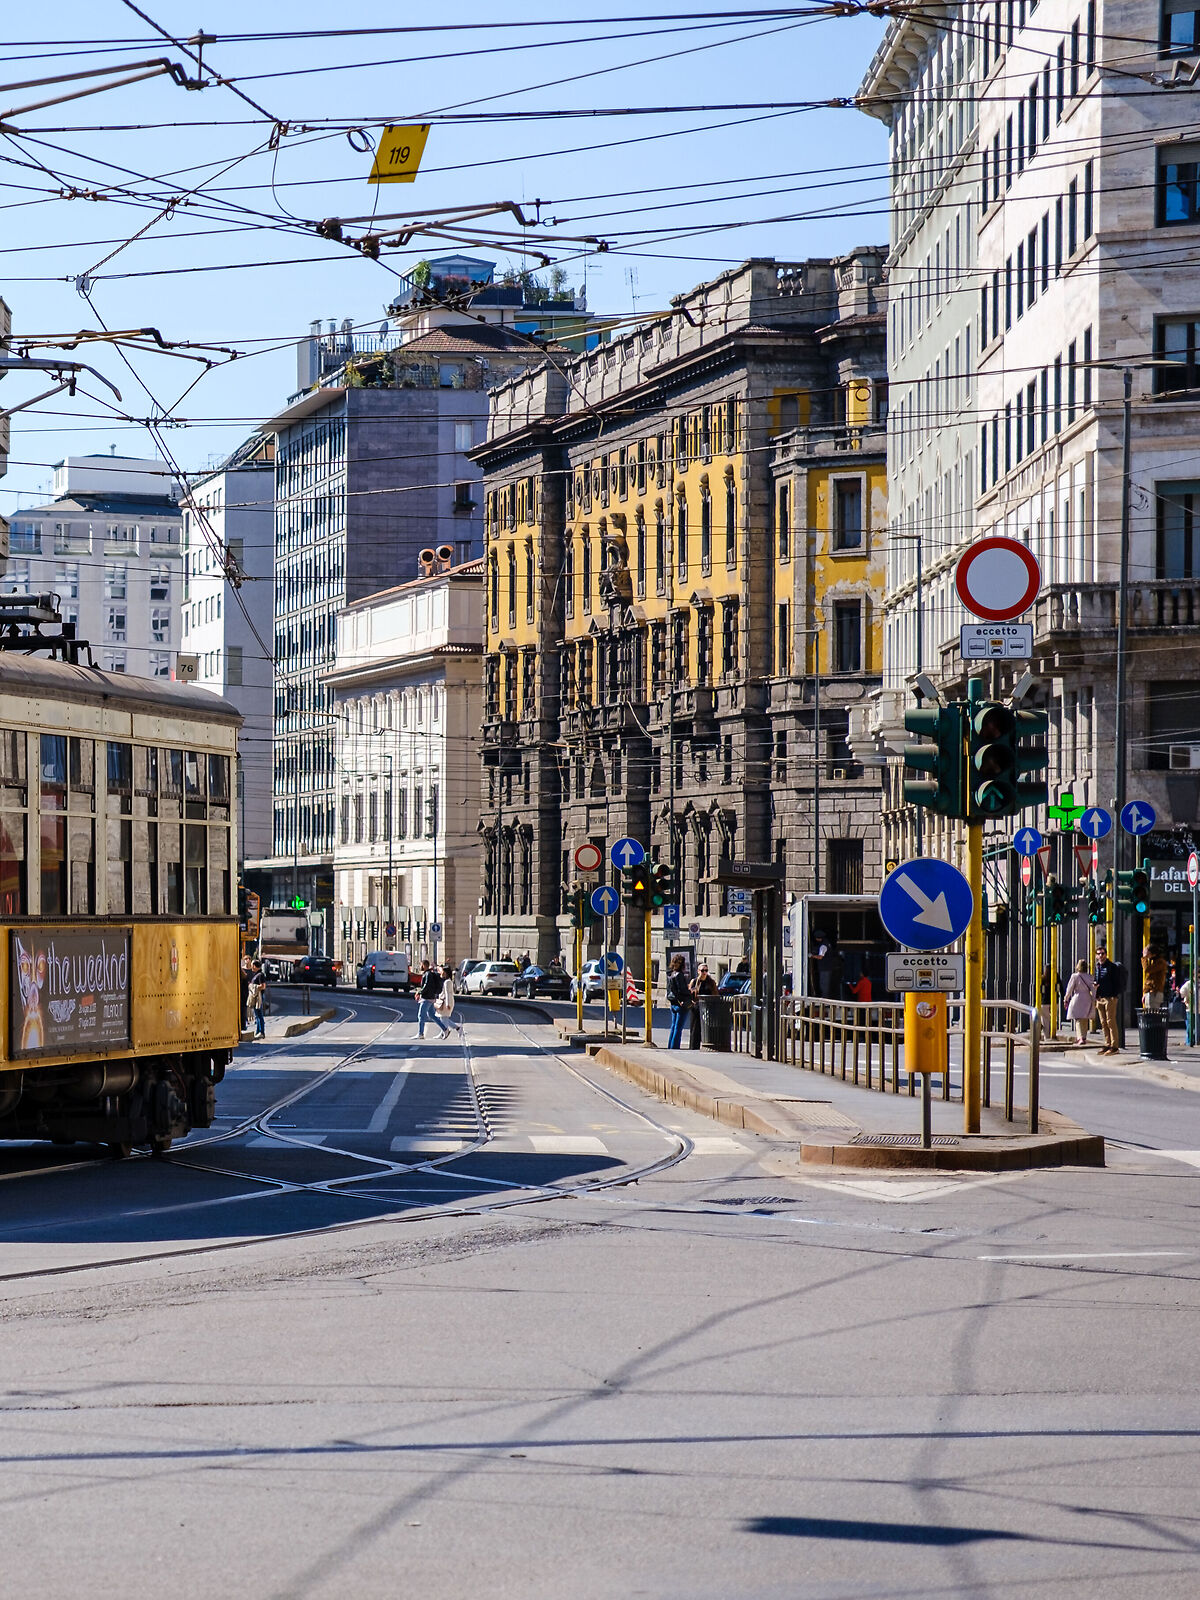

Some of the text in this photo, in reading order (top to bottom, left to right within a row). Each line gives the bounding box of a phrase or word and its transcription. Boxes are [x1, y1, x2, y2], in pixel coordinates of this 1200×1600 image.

[389, 146, 410, 165] 119
[975, 627, 1018, 636] eccetto
[180, 664, 194, 673] 76
[1164, 882, 1187, 893] DEL
[667, 908, 676, 918] P
[47, 938, 128, 995] the weeknd
[902, 957, 948, 966] eccetto
